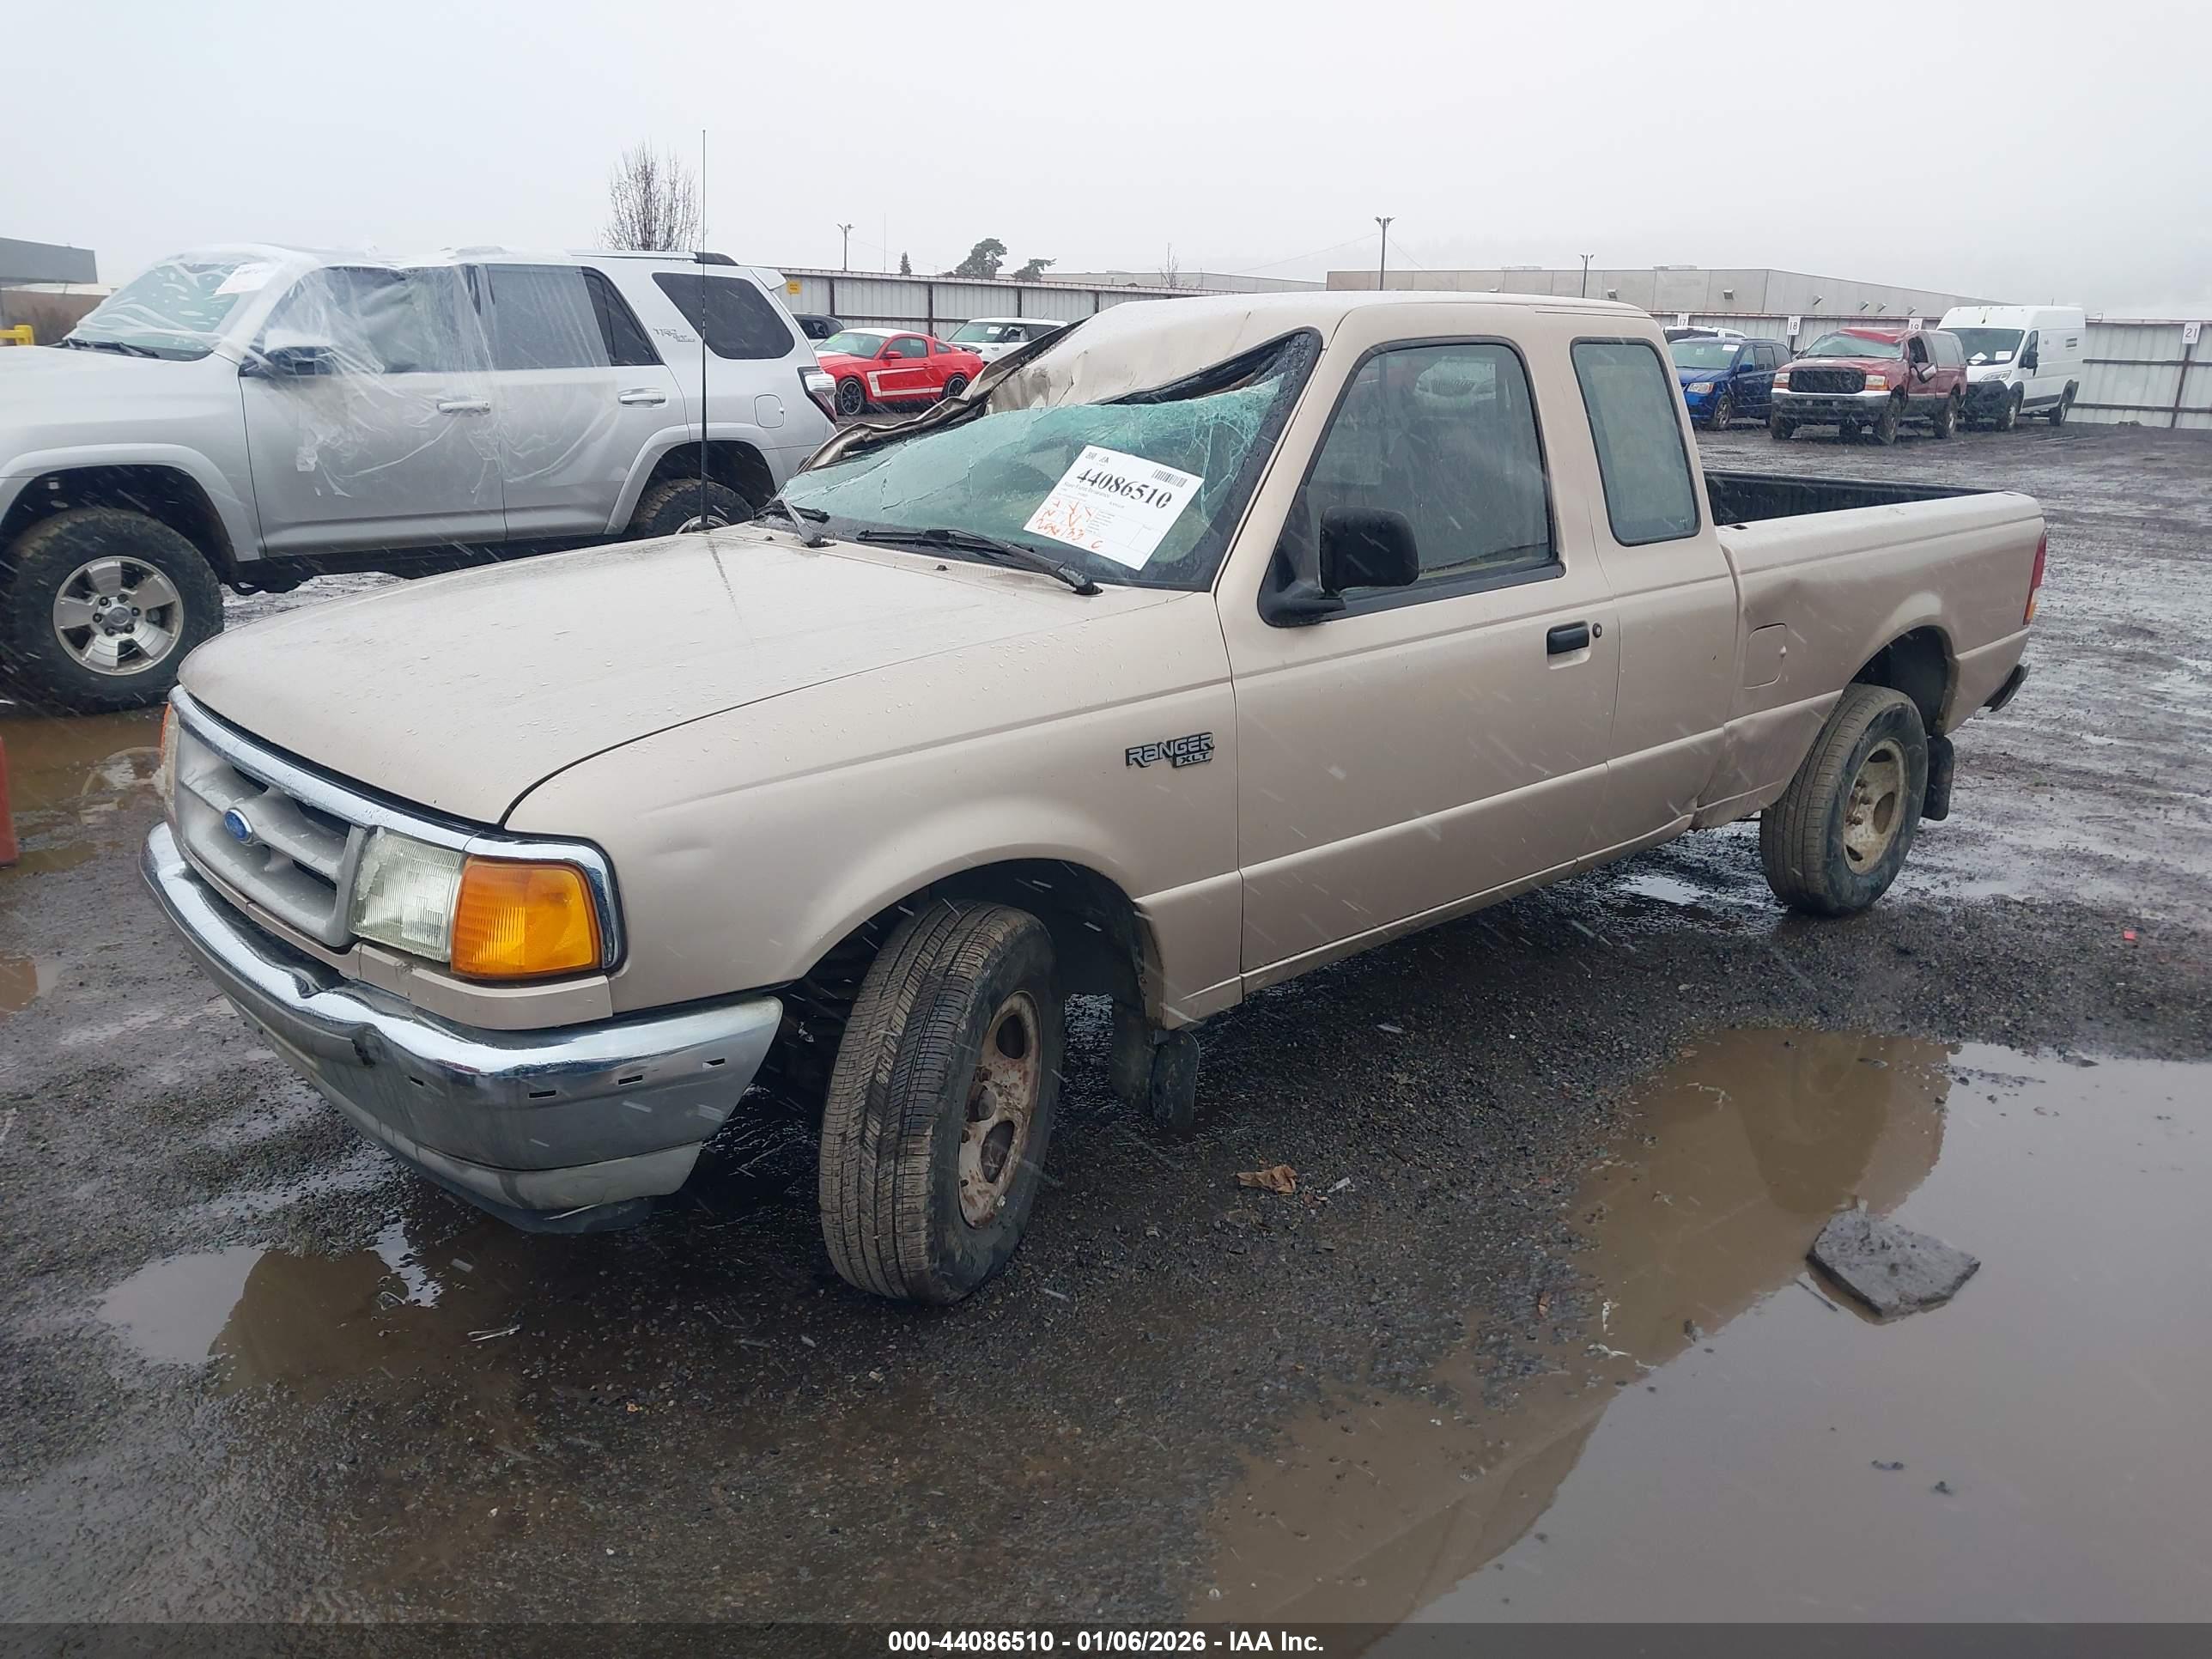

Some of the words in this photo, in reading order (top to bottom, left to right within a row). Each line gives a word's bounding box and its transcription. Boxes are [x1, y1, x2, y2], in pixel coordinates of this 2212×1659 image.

[1790, 321, 1798, 331] 18
[2185, 327, 2198, 338] 21
[1076, 468, 1173, 509] 44086510
[1125, 732, 1215, 768] RANGER
[1177, 750, 1211, 765] XLT
